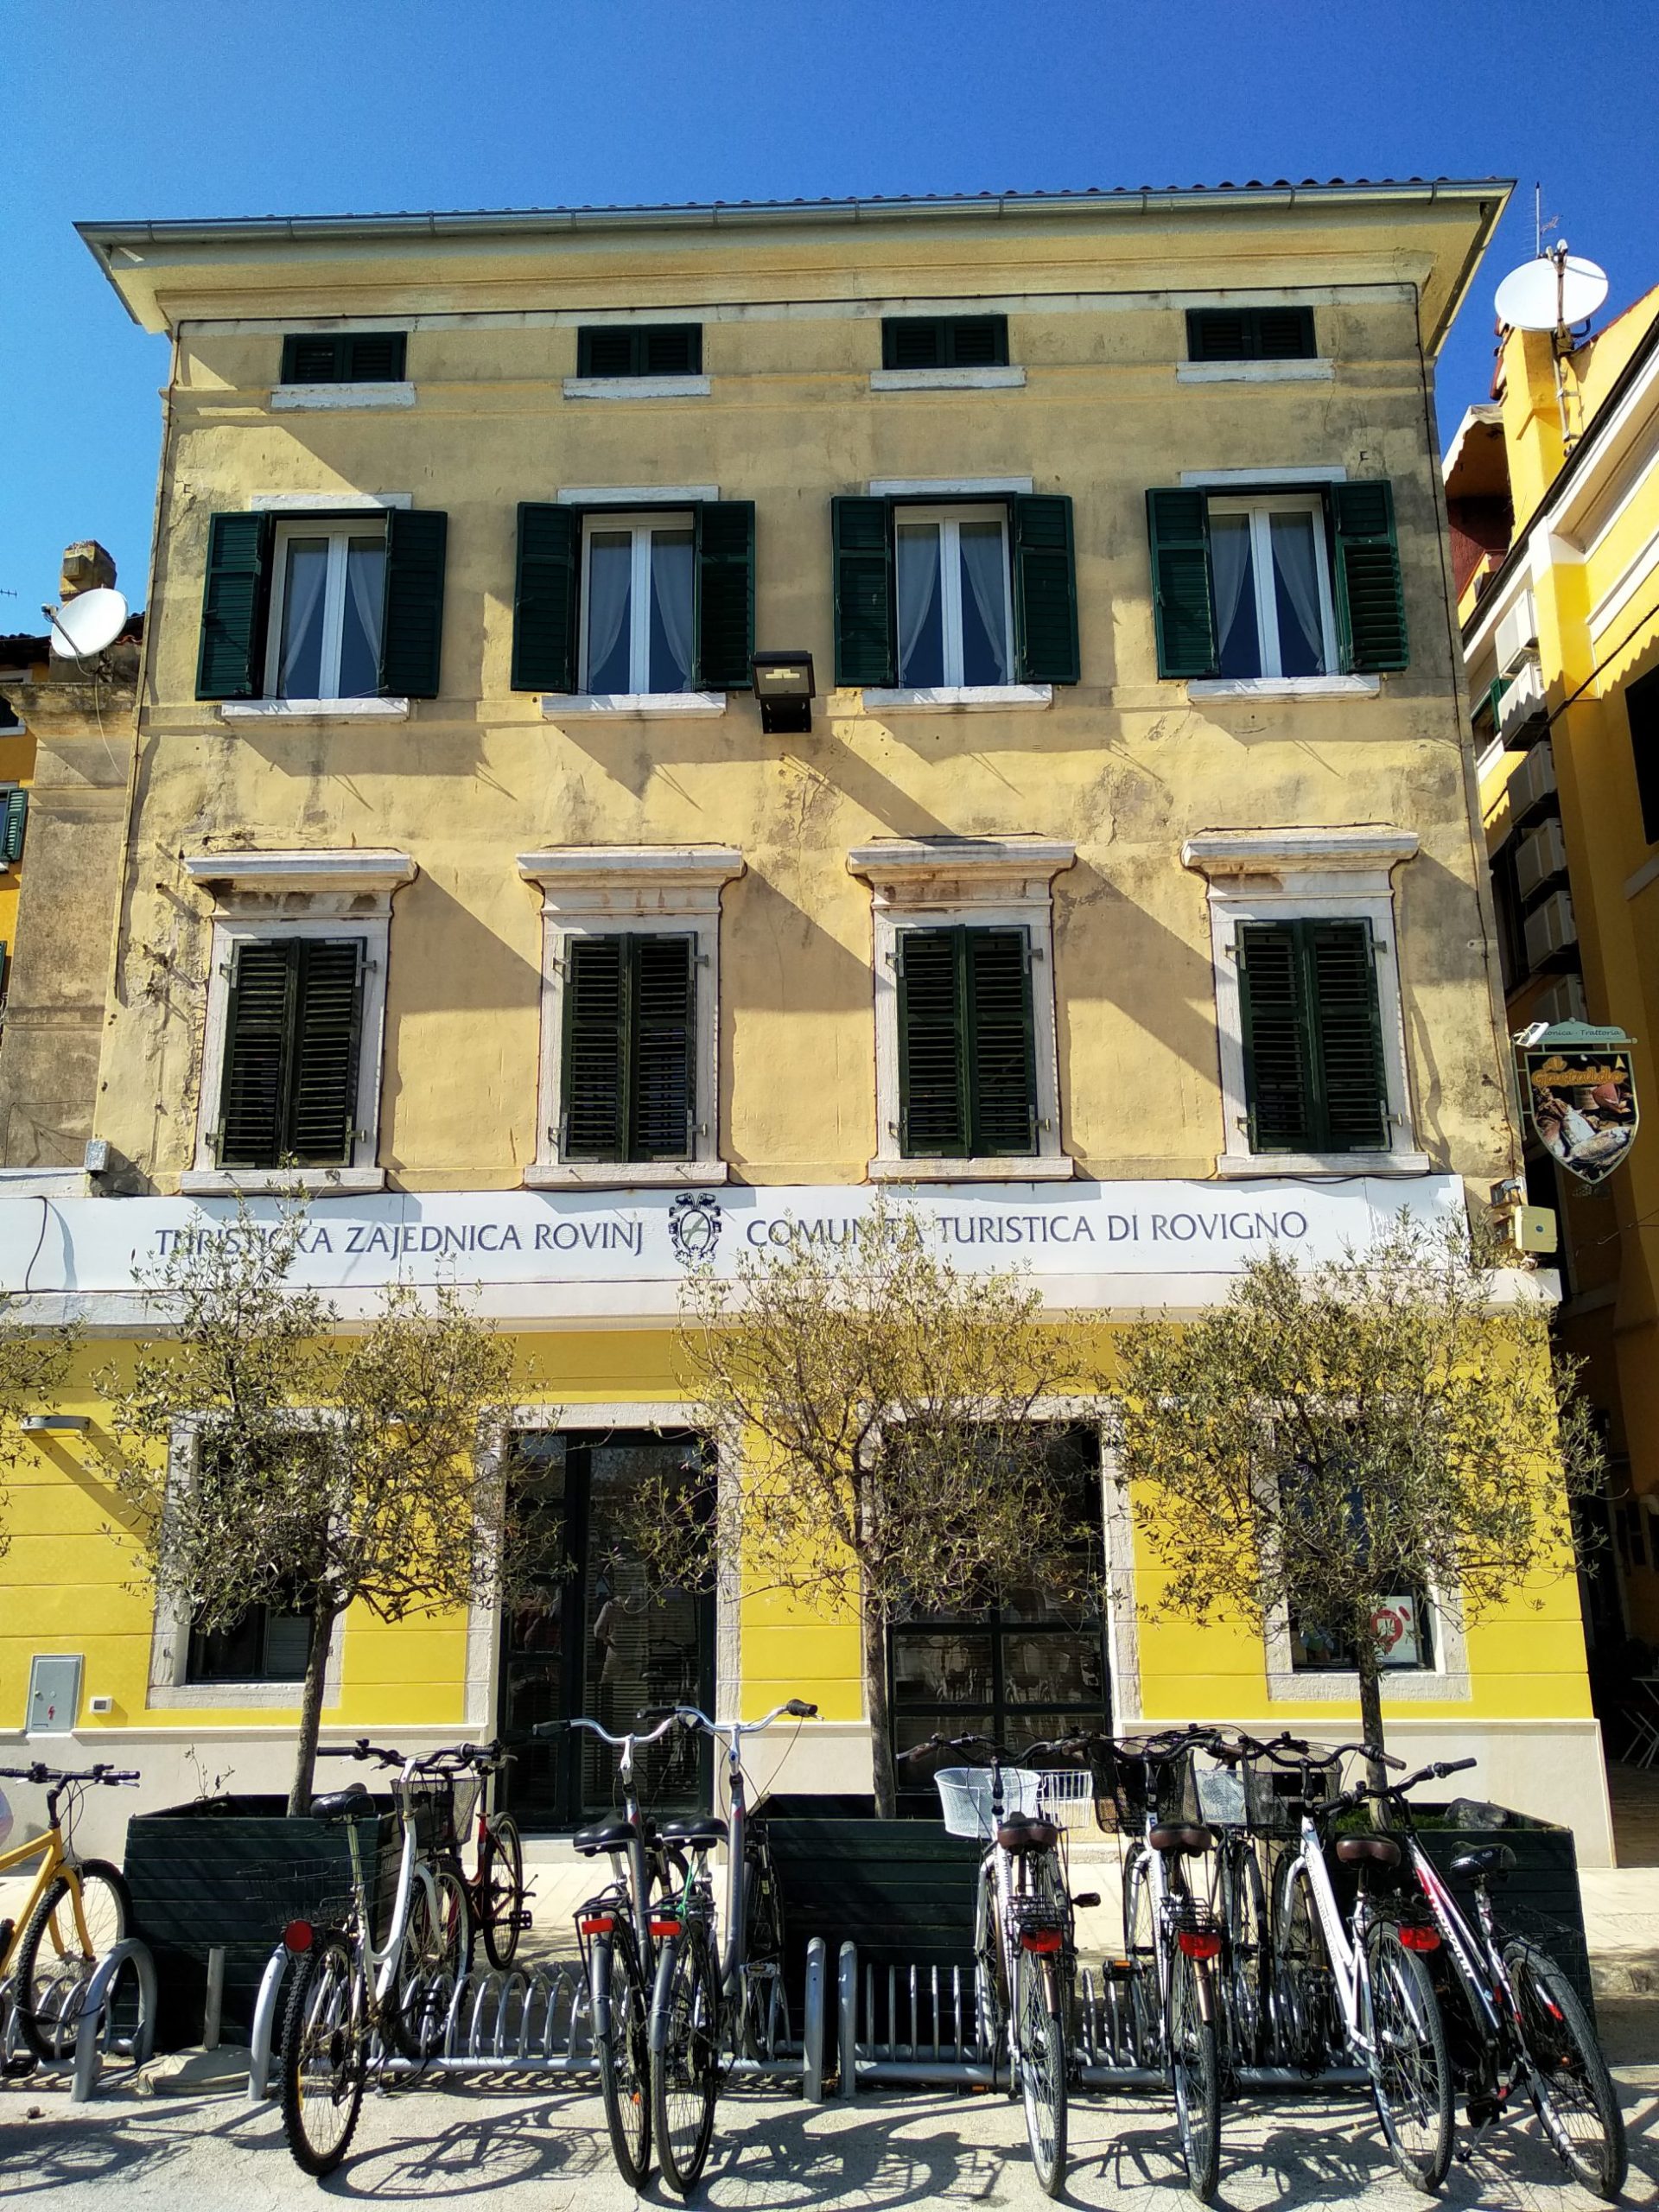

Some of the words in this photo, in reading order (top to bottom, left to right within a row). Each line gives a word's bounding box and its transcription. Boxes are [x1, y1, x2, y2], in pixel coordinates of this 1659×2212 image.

[155, 1227, 334, 1255] TURSKA
[344, 1224, 523, 1260] ZAJEDNICA
[534, 1222, 643, 1256] ROVINJ
[938, 1215, 1096, 1243] TURISTICA
[1108, 1213, 1139, 1242] DI
[1152, 1211, 1307, 1241] ROVIGNO
[1306, 1850, 1338, 1964] ww.portaantica.com
